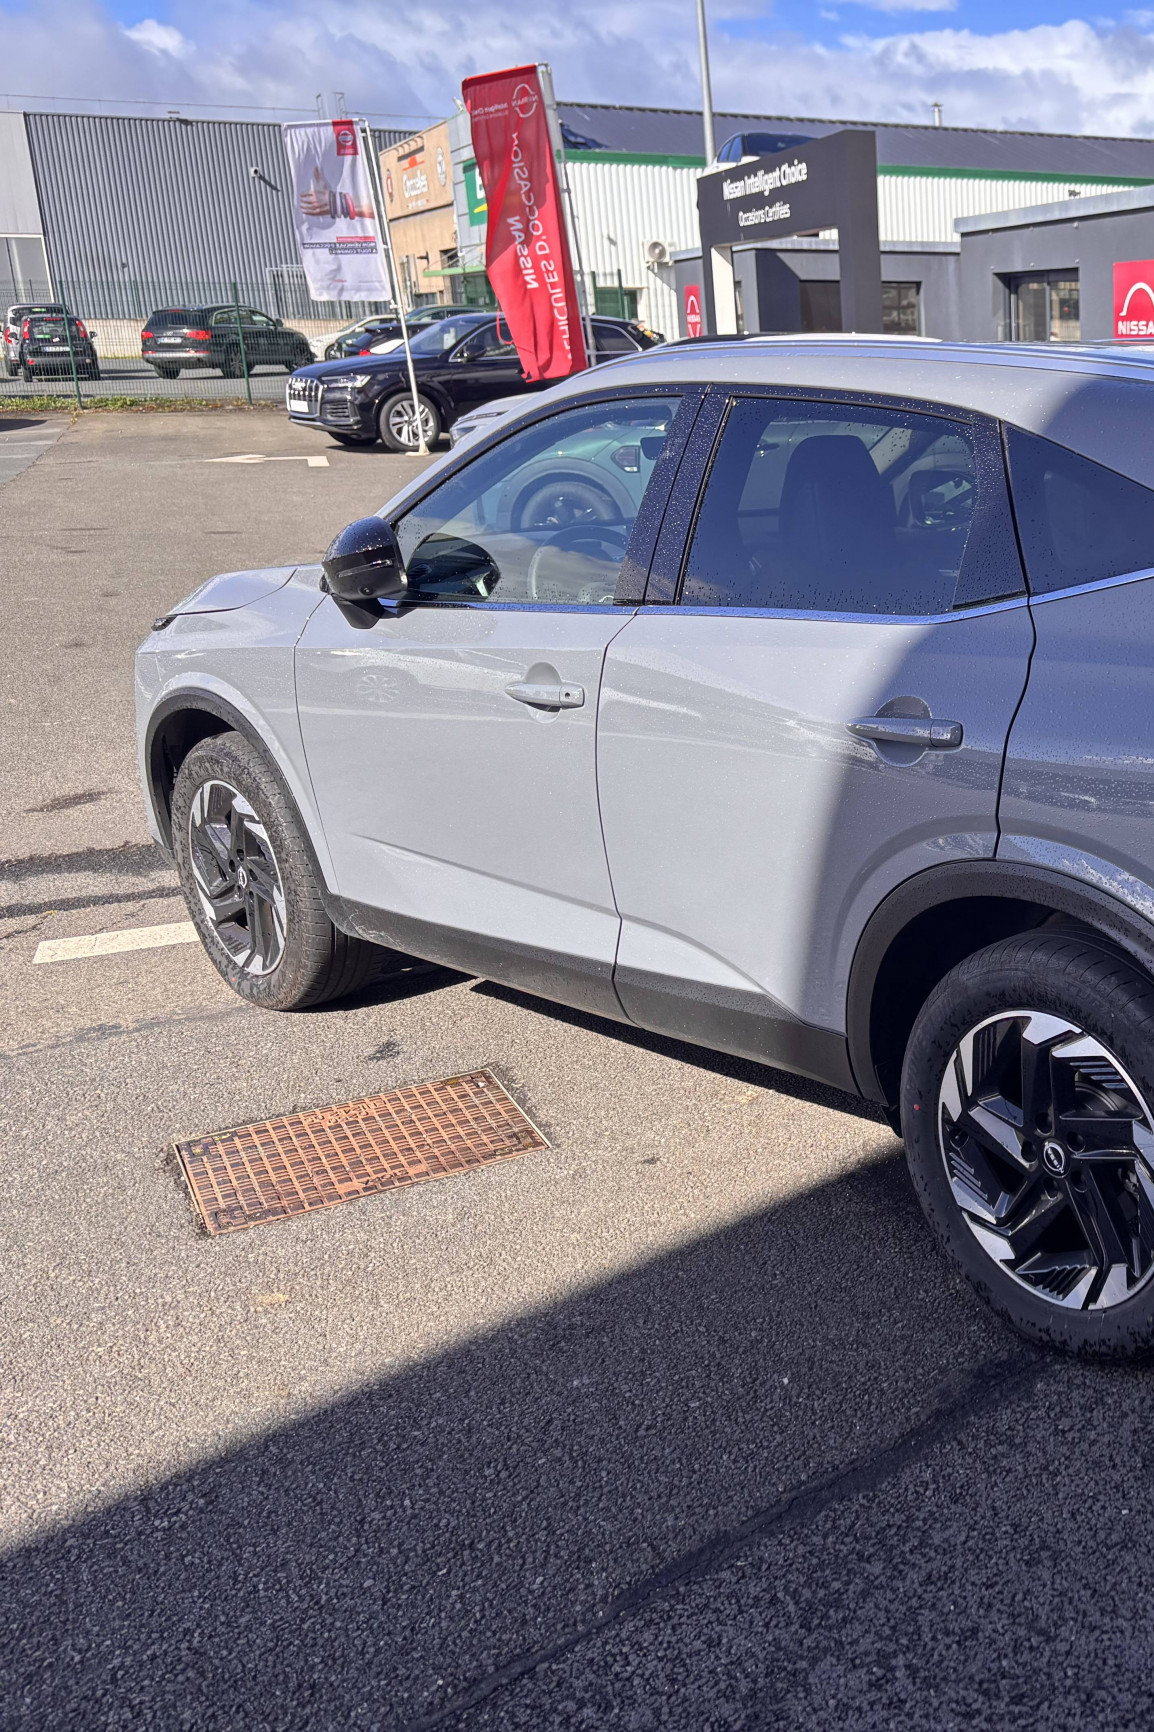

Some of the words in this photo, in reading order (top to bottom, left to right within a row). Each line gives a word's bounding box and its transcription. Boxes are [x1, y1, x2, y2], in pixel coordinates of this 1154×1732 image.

[722, 178, 745, 200] Nissan
[745, 166, 781, 196] Intelligent
[781, 158, 807, 186] Choice
[738, 208, 765, 227] Occasions
